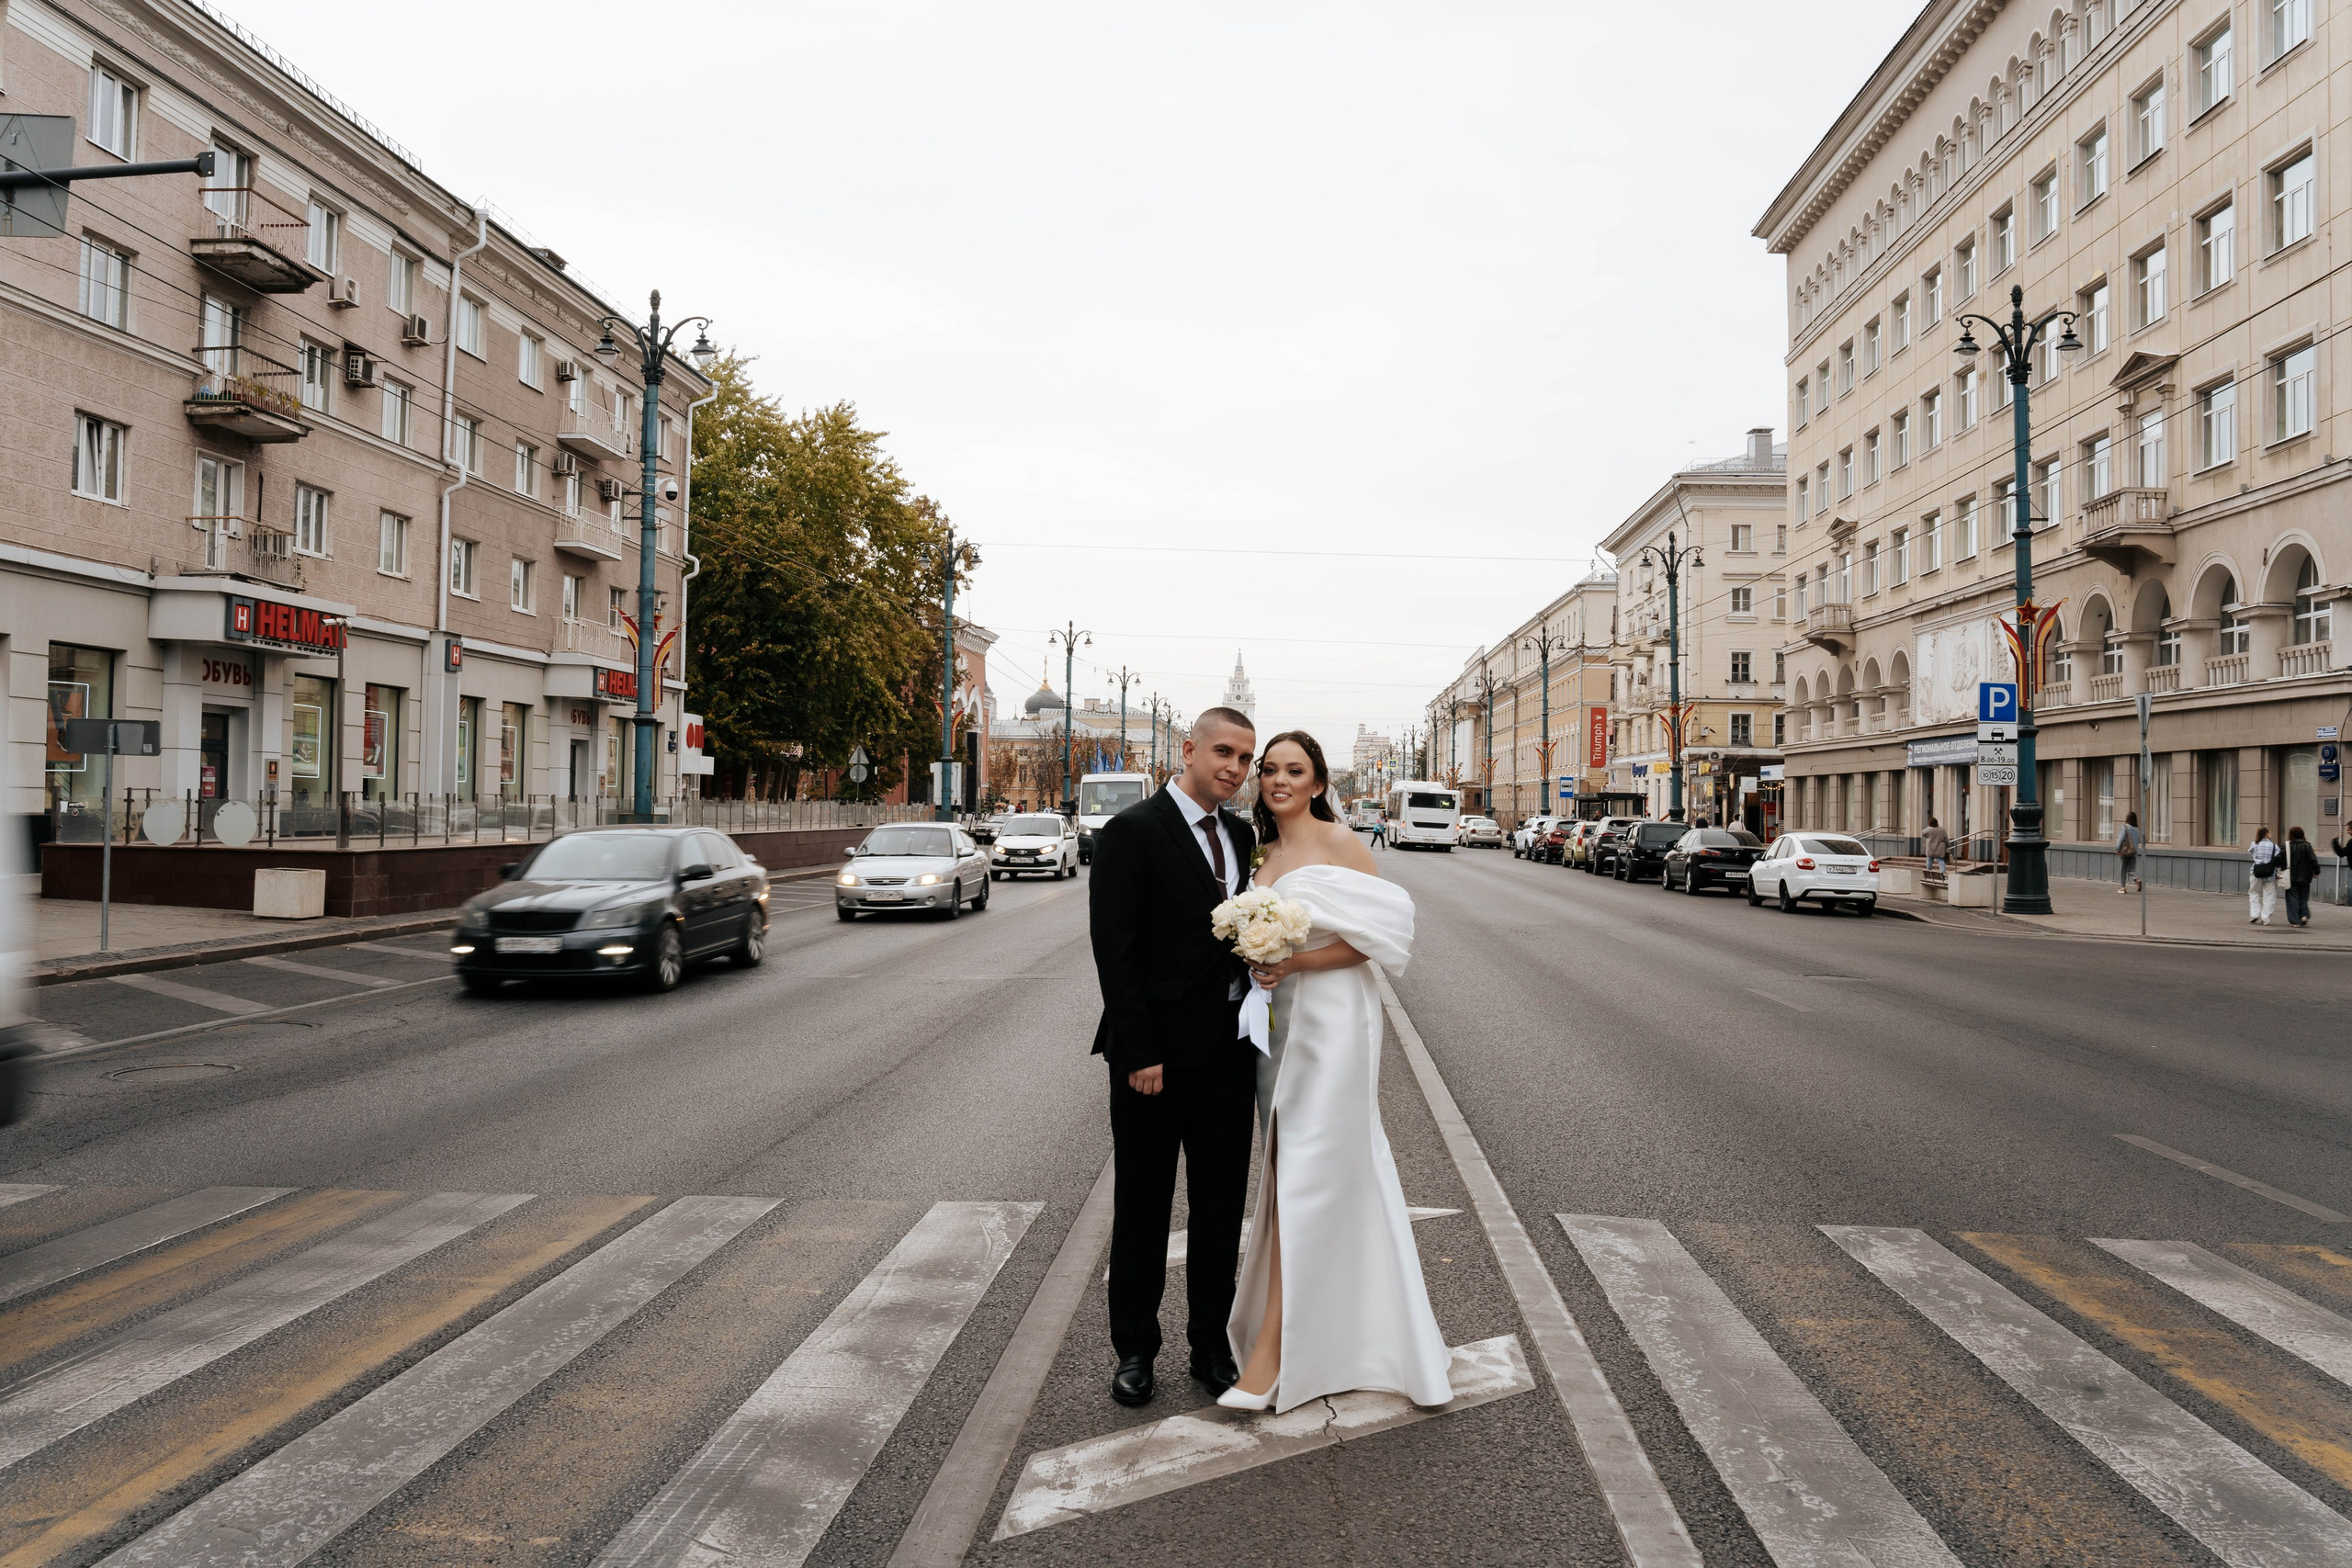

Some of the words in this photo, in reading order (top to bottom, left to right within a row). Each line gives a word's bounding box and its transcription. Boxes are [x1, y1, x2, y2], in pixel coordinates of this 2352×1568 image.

[297, 646, 339, 657] комфор
[1989, 686, 2010, 718] P
[571, 709, 591, 726] БУВЬ
[1592, 723, 1604, 761] Triumph
[1950, 738, 1978, 751] ОТДЕЛЕНИ
[1980, 756, 2015, 764] 8.00-19.00
[2001, 771, 2013, 780] 20
